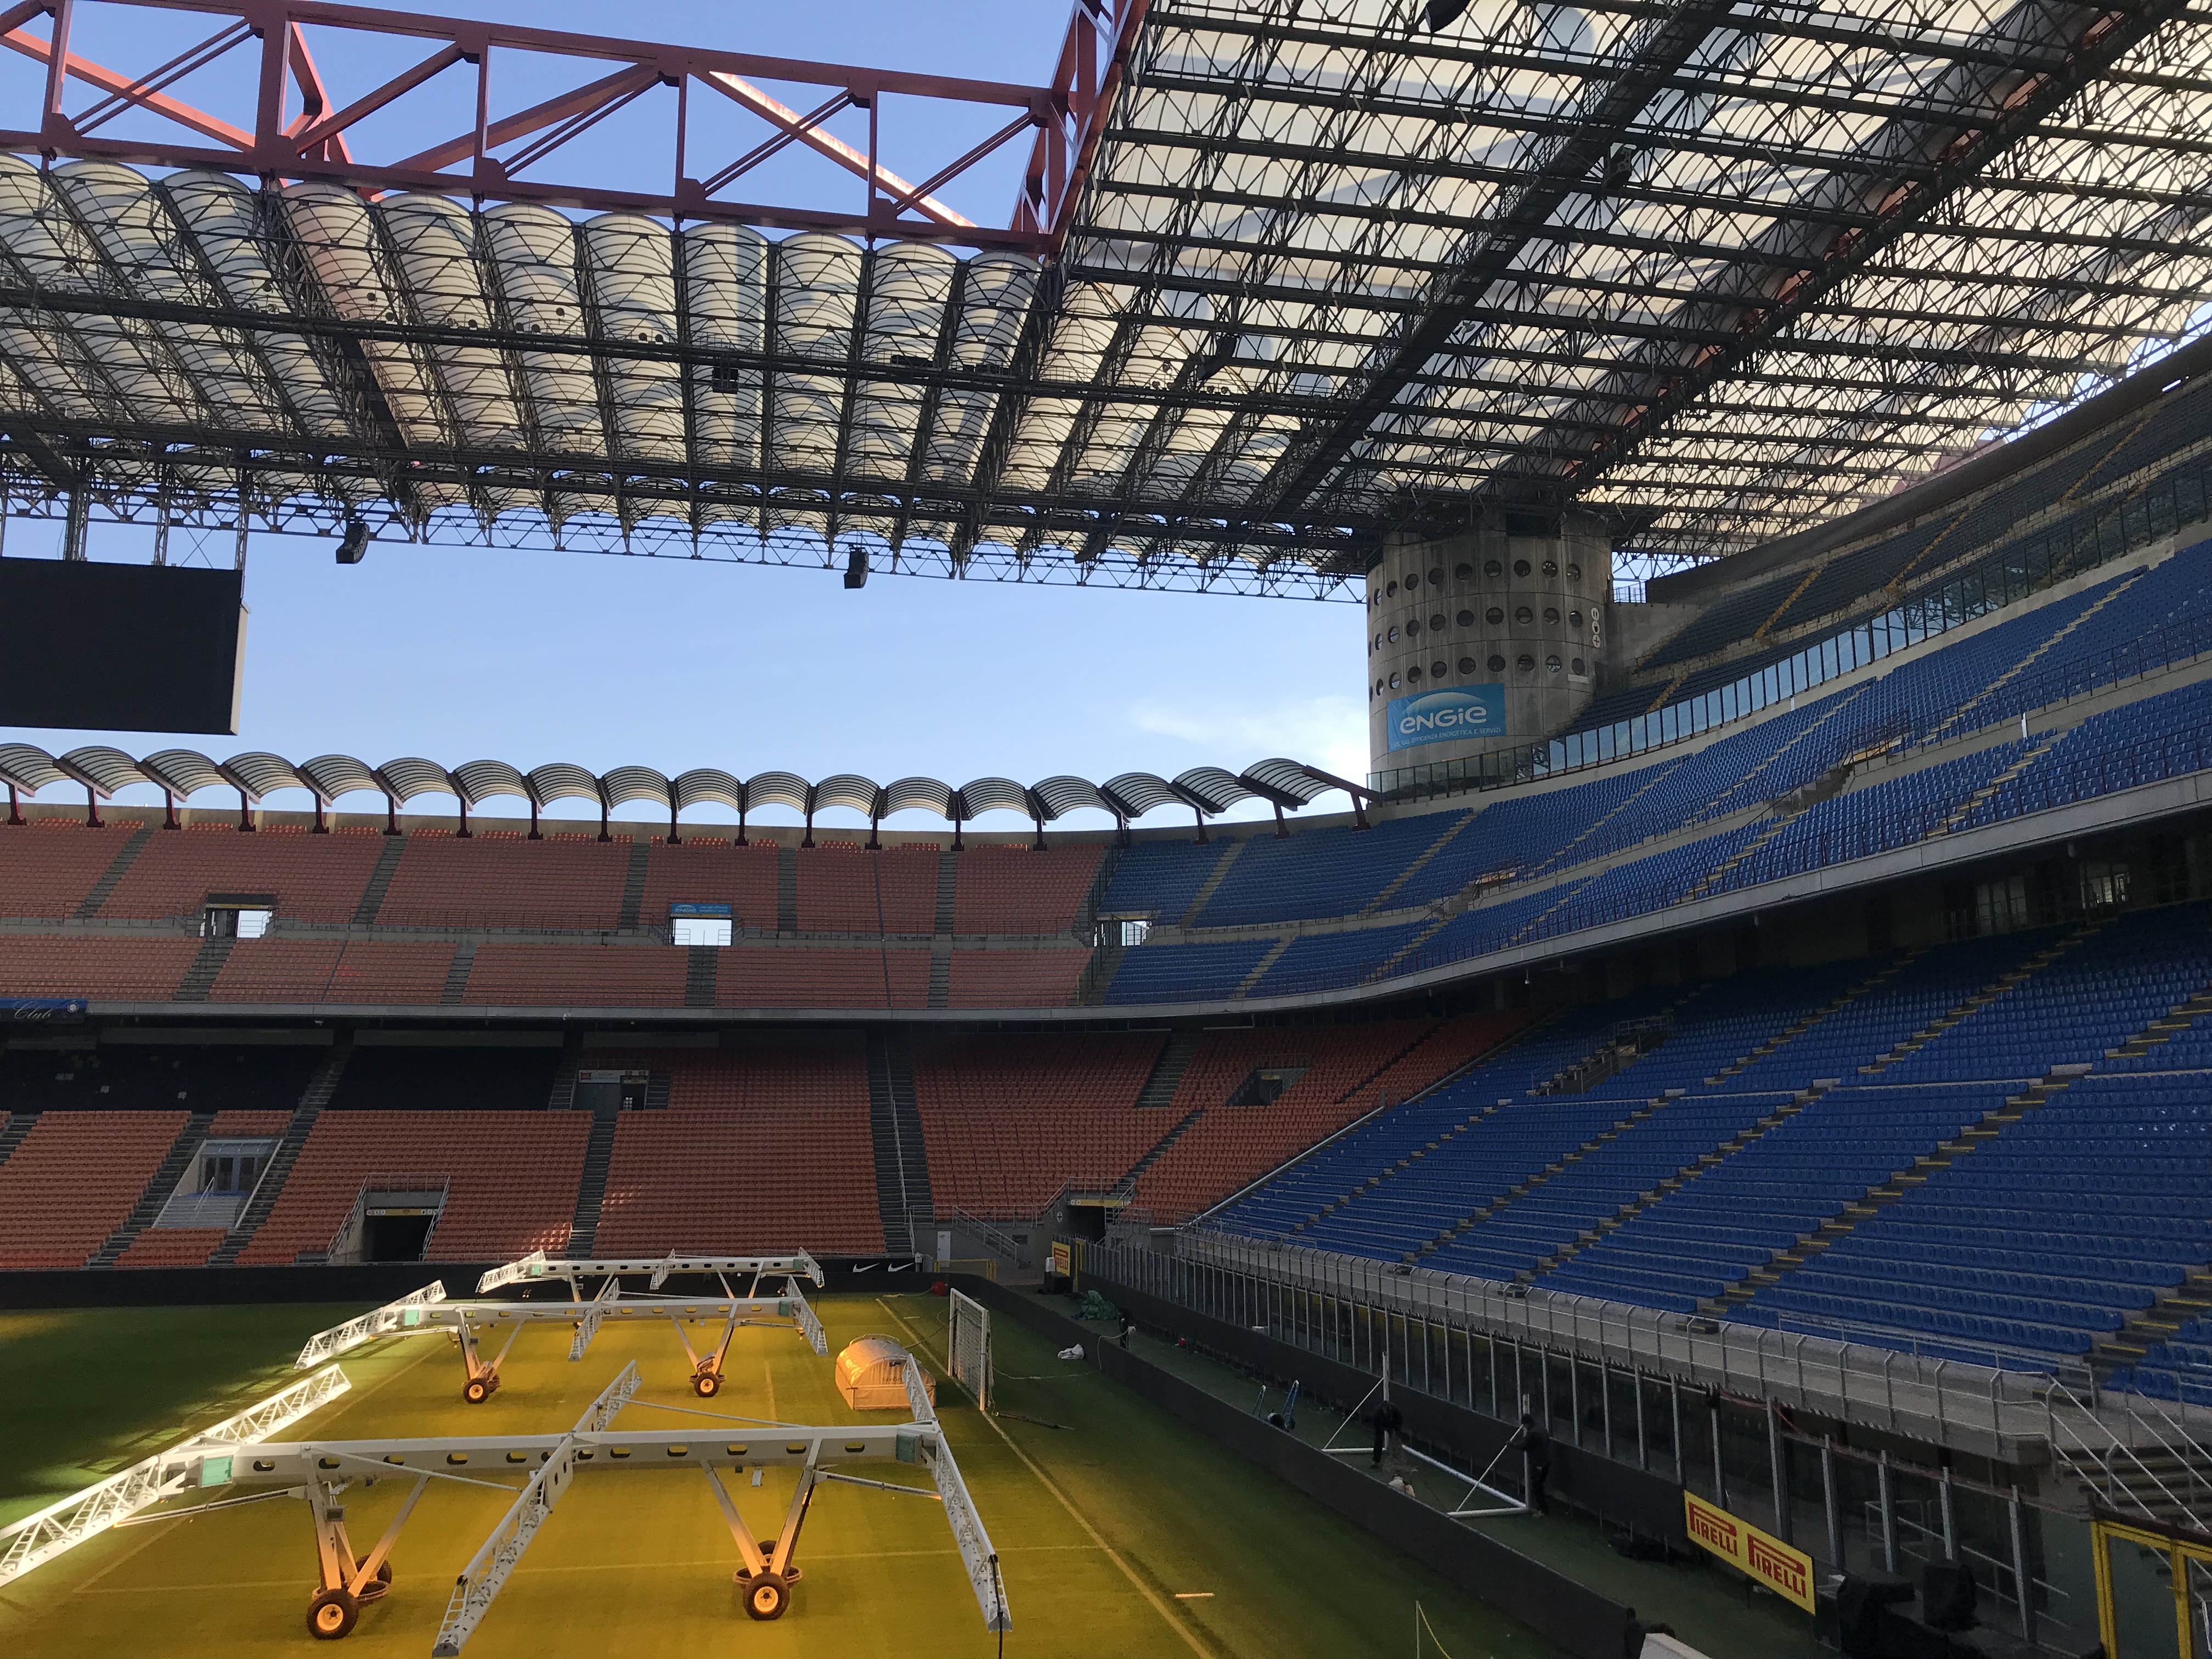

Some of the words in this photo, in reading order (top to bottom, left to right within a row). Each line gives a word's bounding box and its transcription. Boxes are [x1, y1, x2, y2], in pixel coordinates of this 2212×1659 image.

[1438, 729, 1472, 738] ENERGETICA
[1688, 1501, 1738, 1557] PIRELLI
[1747, 1533, 1807, 1599] PIRELLI
